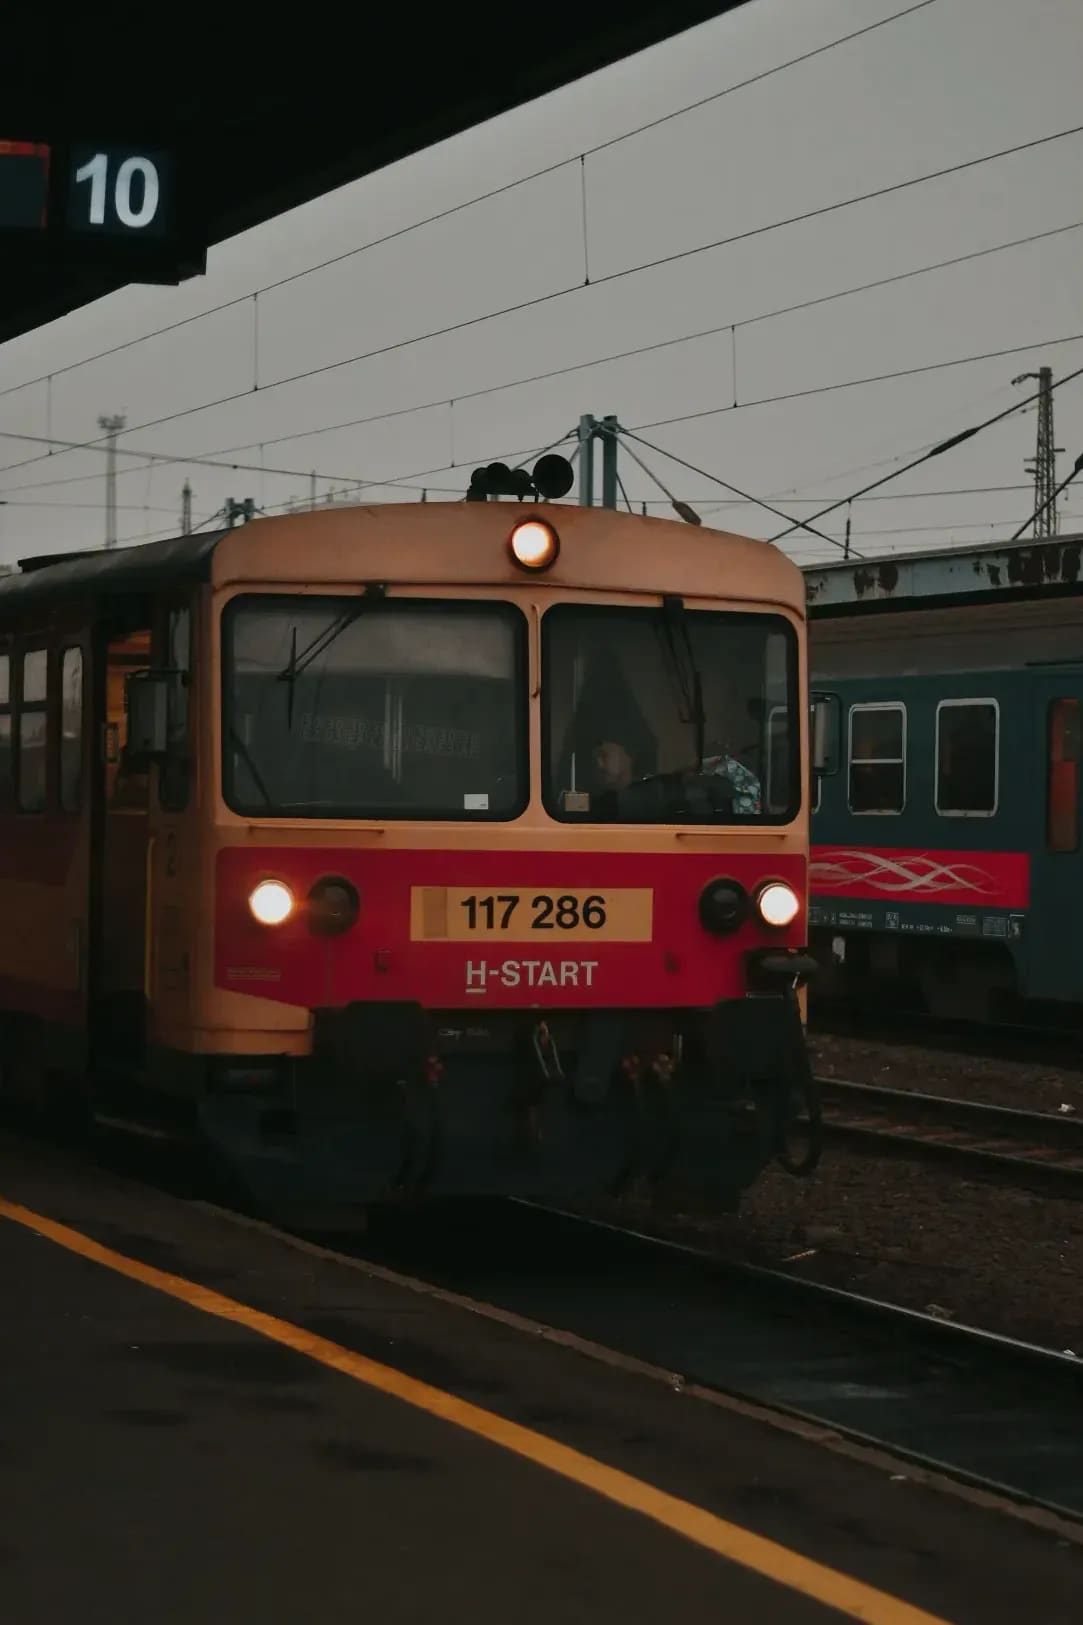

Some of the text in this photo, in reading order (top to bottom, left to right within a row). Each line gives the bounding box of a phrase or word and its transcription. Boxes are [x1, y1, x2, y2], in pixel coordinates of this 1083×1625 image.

[75, 153, 160, 229] 10
[461, 895, 607, 930] 117 286
[465, 959, 599, 993] H-START
